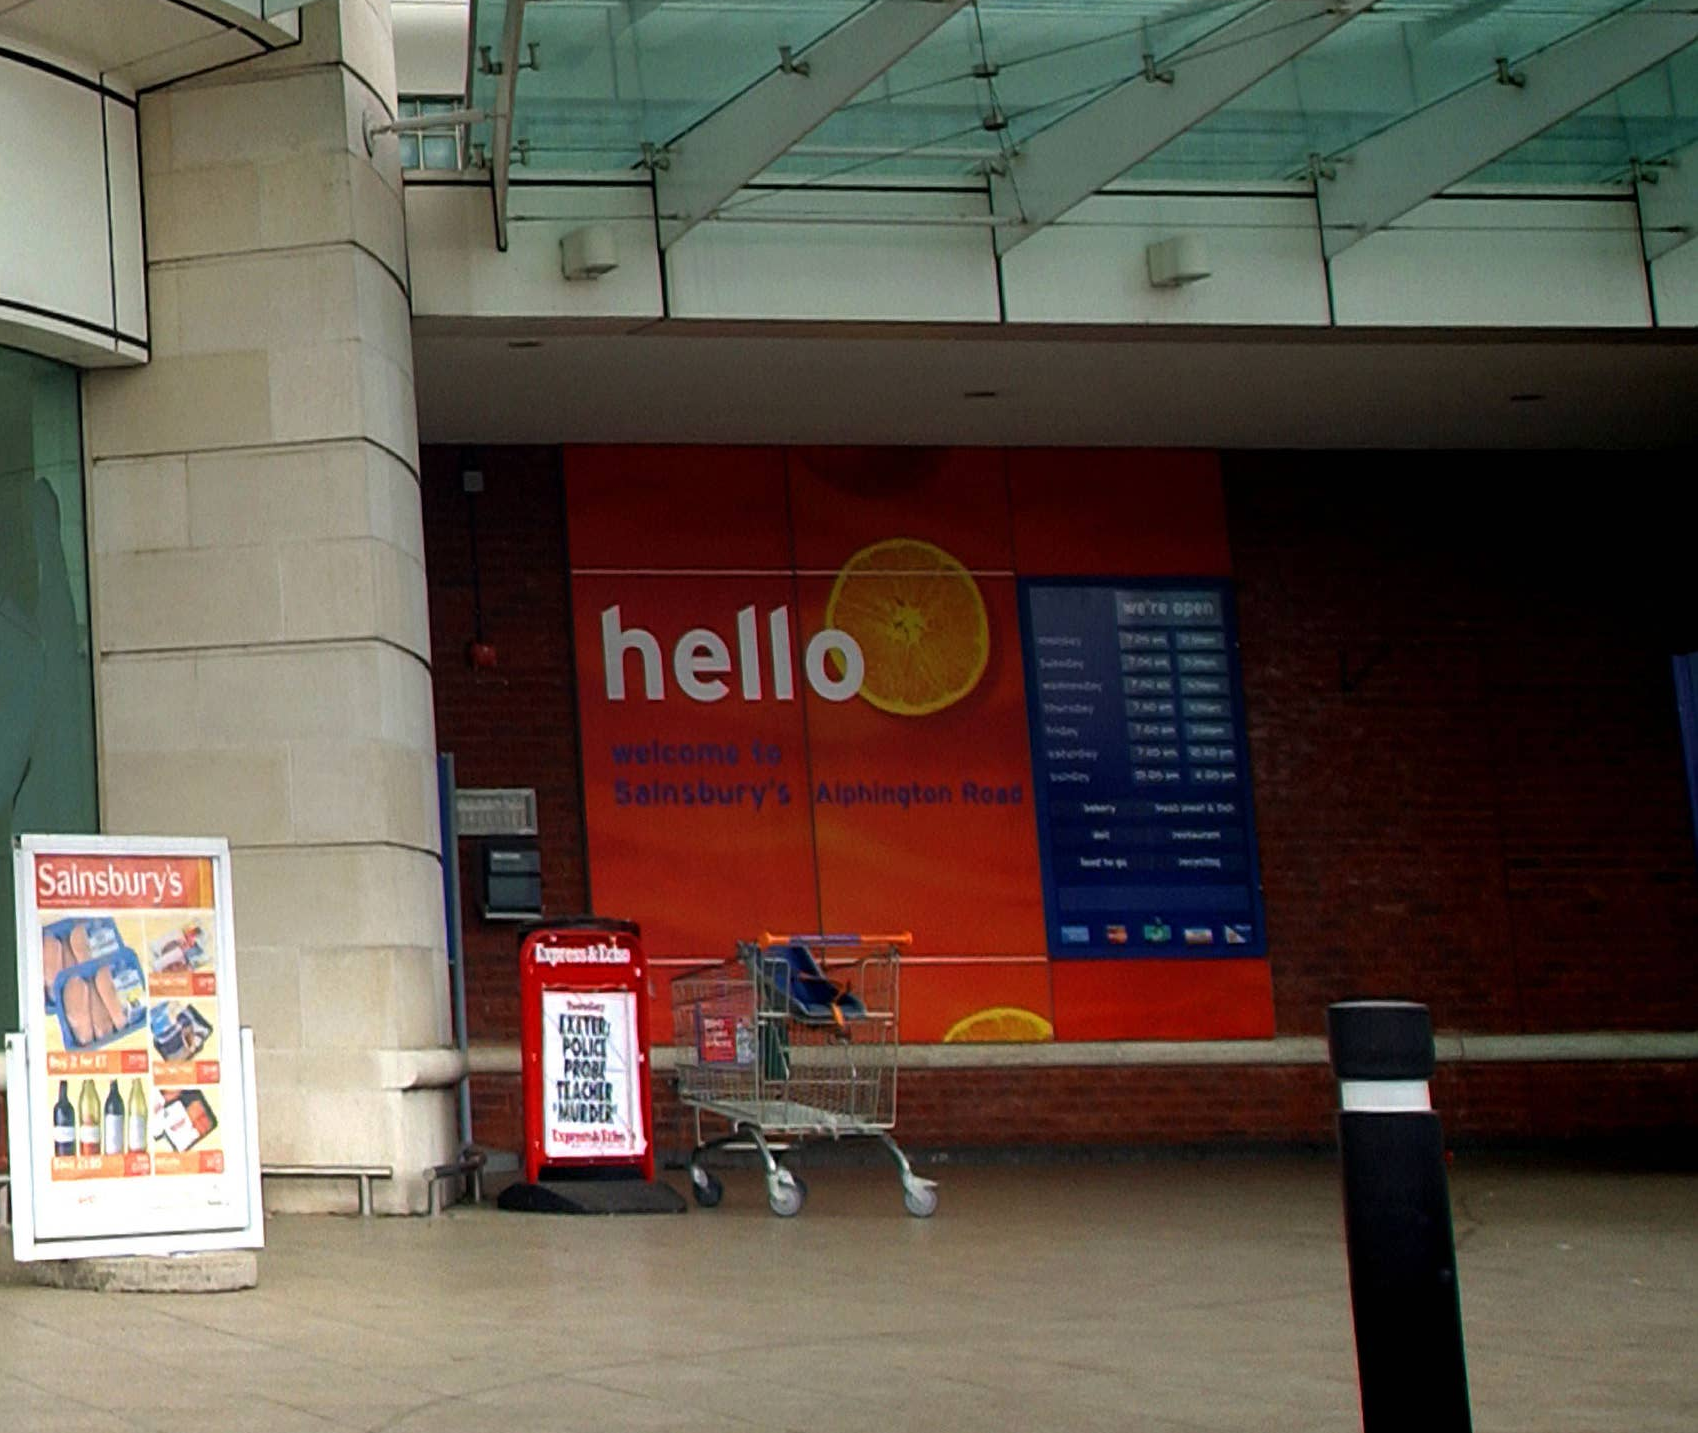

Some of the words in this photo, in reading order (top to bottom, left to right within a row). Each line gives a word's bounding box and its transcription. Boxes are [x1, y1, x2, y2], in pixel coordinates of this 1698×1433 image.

[1173, 601, 1214, 618] open
[601, 605, 864, 702] hello
[611, 740, 740, 766] welcome
[751, 740, 782, 766] to
[614, 778, 791, 812] Sainsbury's
[816, 781, 952, 810] Alphington
[962, 781, 1023, 806] Road
[38, 863, 183, 903] Sainsbury's
[562, 1036, 607, 1058] POLICE
[556, 1081, 613, 1103] TEACHER
